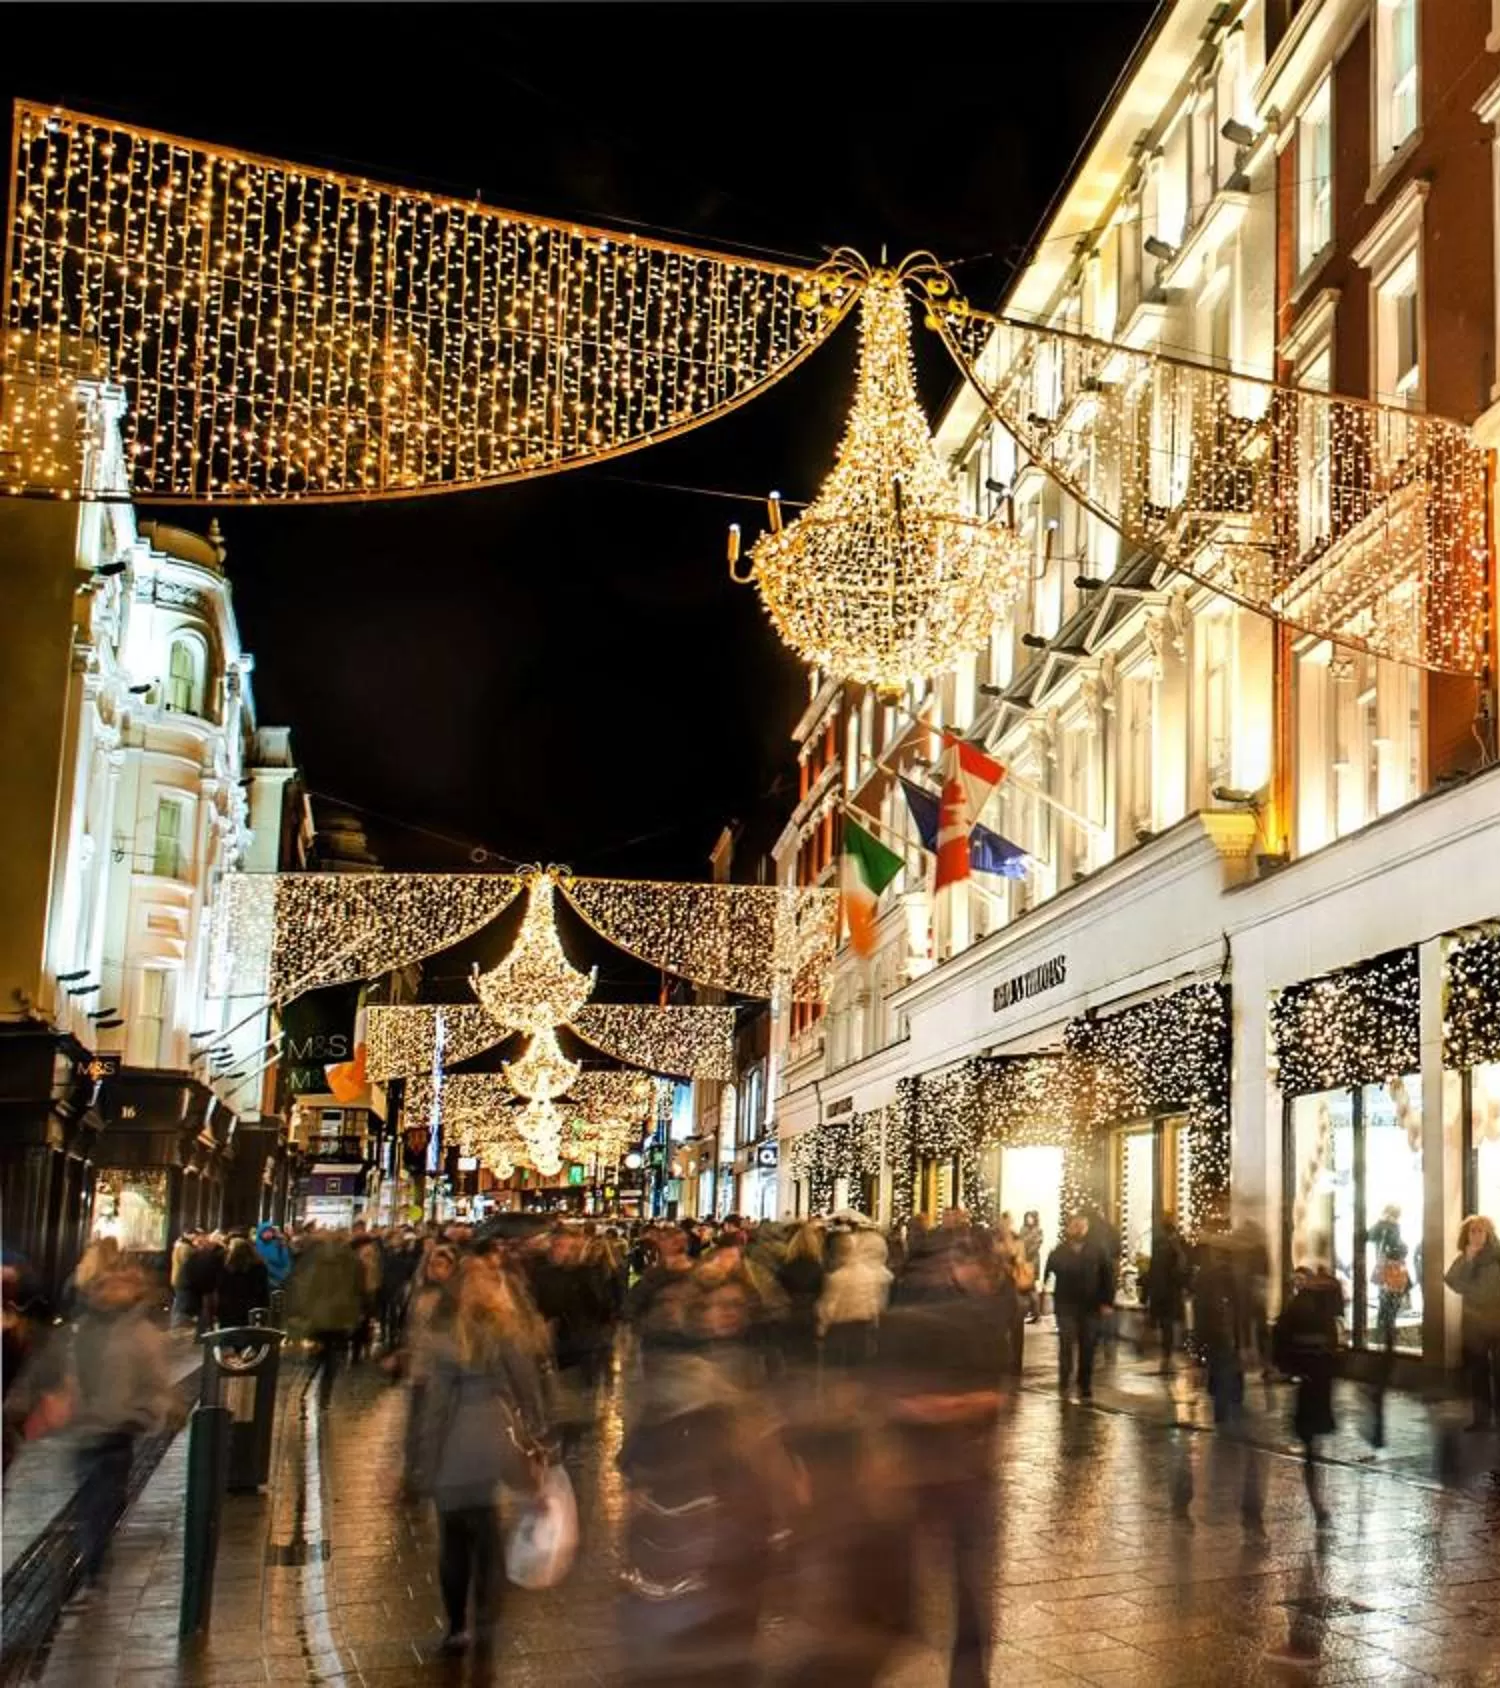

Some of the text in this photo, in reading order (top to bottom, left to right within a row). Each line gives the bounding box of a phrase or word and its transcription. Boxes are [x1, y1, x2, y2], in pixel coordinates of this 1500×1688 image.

[287, 1034, 348, 1059] M&S
[76, 1061, 116, 1076] M&S
[121, 1106, 136, 1119] 16
